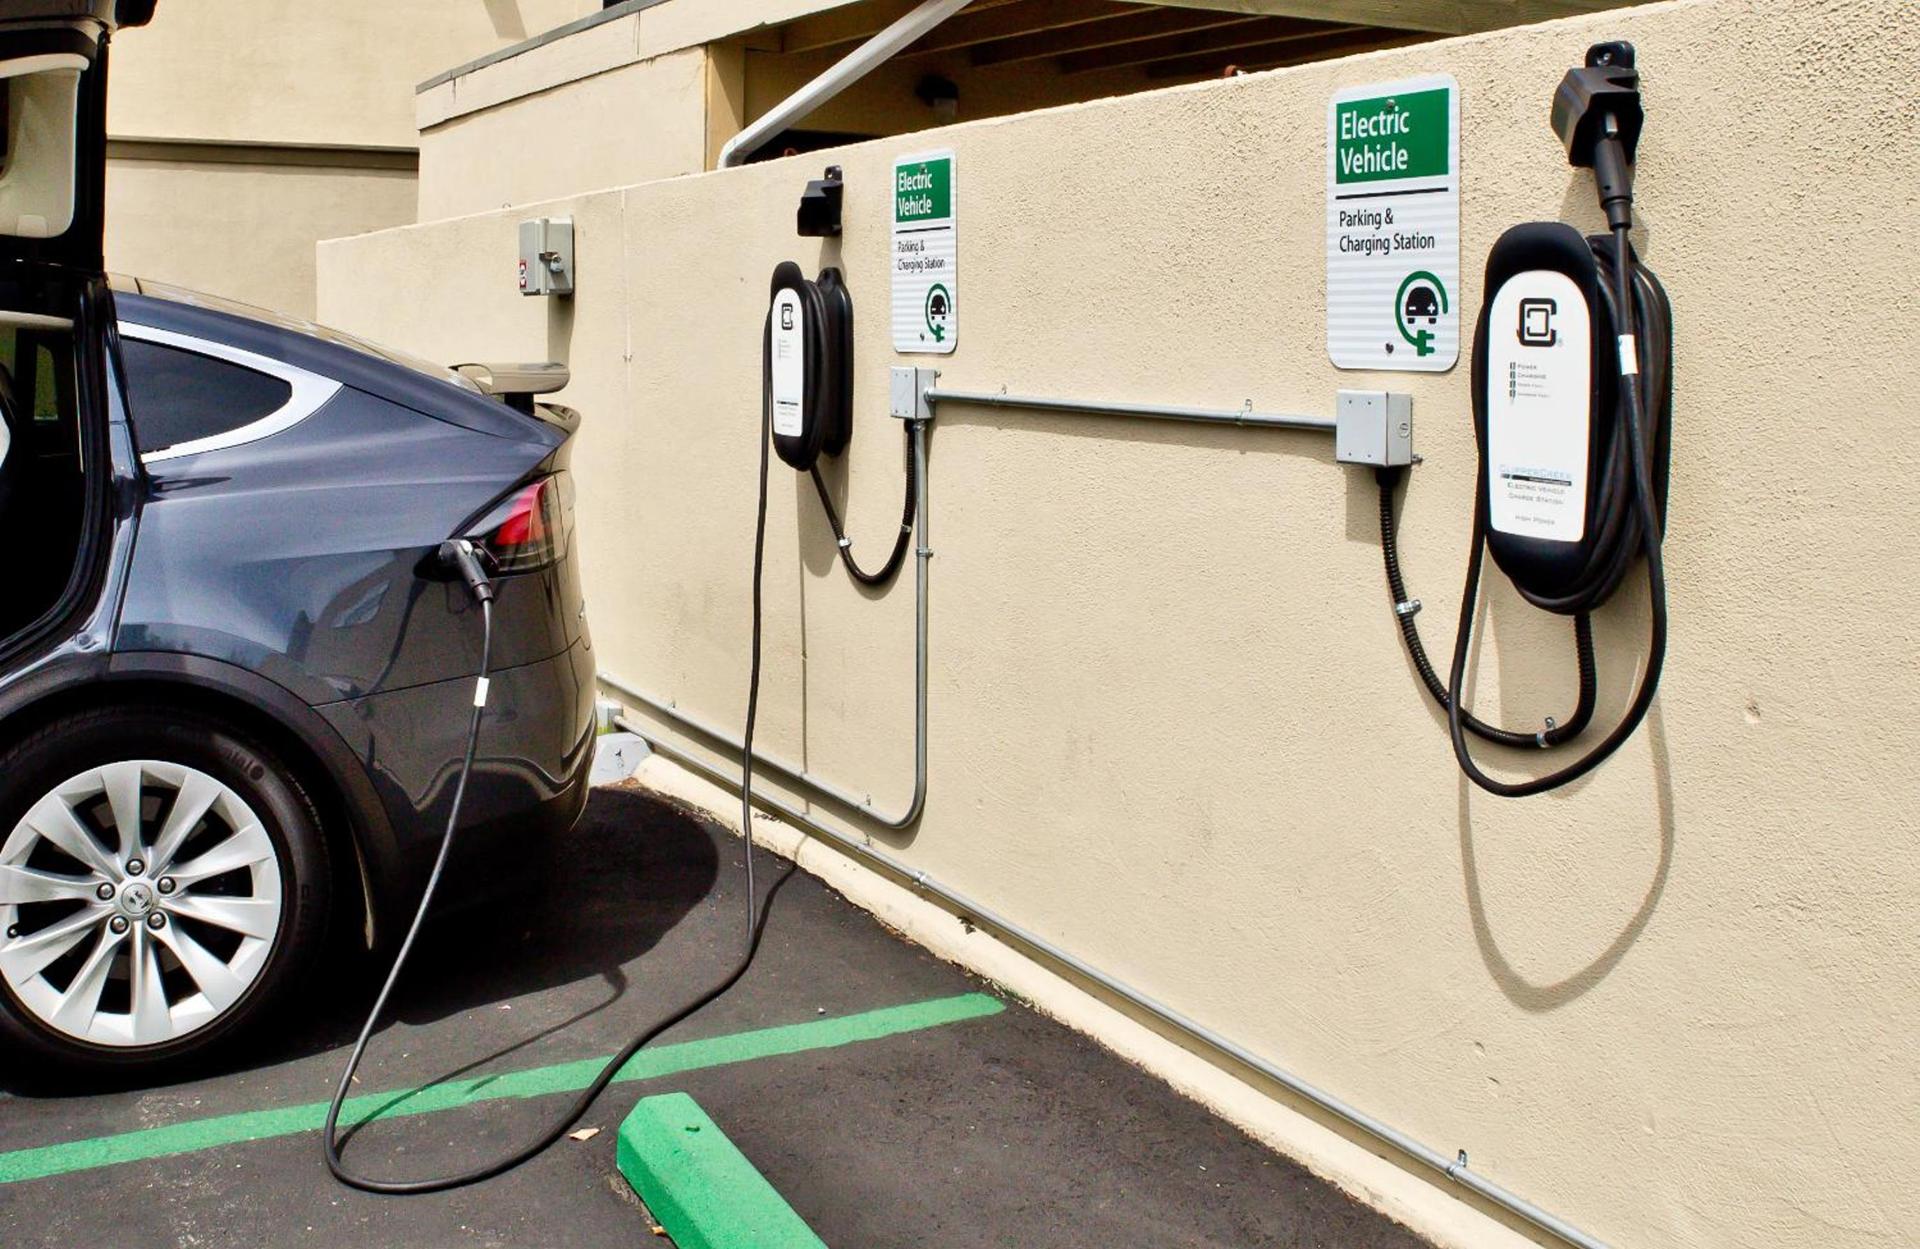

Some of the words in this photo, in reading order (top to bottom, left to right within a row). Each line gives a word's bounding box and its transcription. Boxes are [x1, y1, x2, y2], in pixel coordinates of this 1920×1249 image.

[1341, 107, 1410, 140] Electric
[1341, 142, 1408, 175] Vehicle
[898, 169, 932, 192] Electric
[898, 194, 932, 217] Vehicle
[1339, 209, 1382, 230] Parking
[1385, 208, 1394, 225] &
[898, 241, 919, 255] Parking
[1339, 234, 1390, 256] Charging
[1393, 231, 1435, 251] Station
[898, 258, 923, 274] Charging
[924, 256, 945, 270] Station
